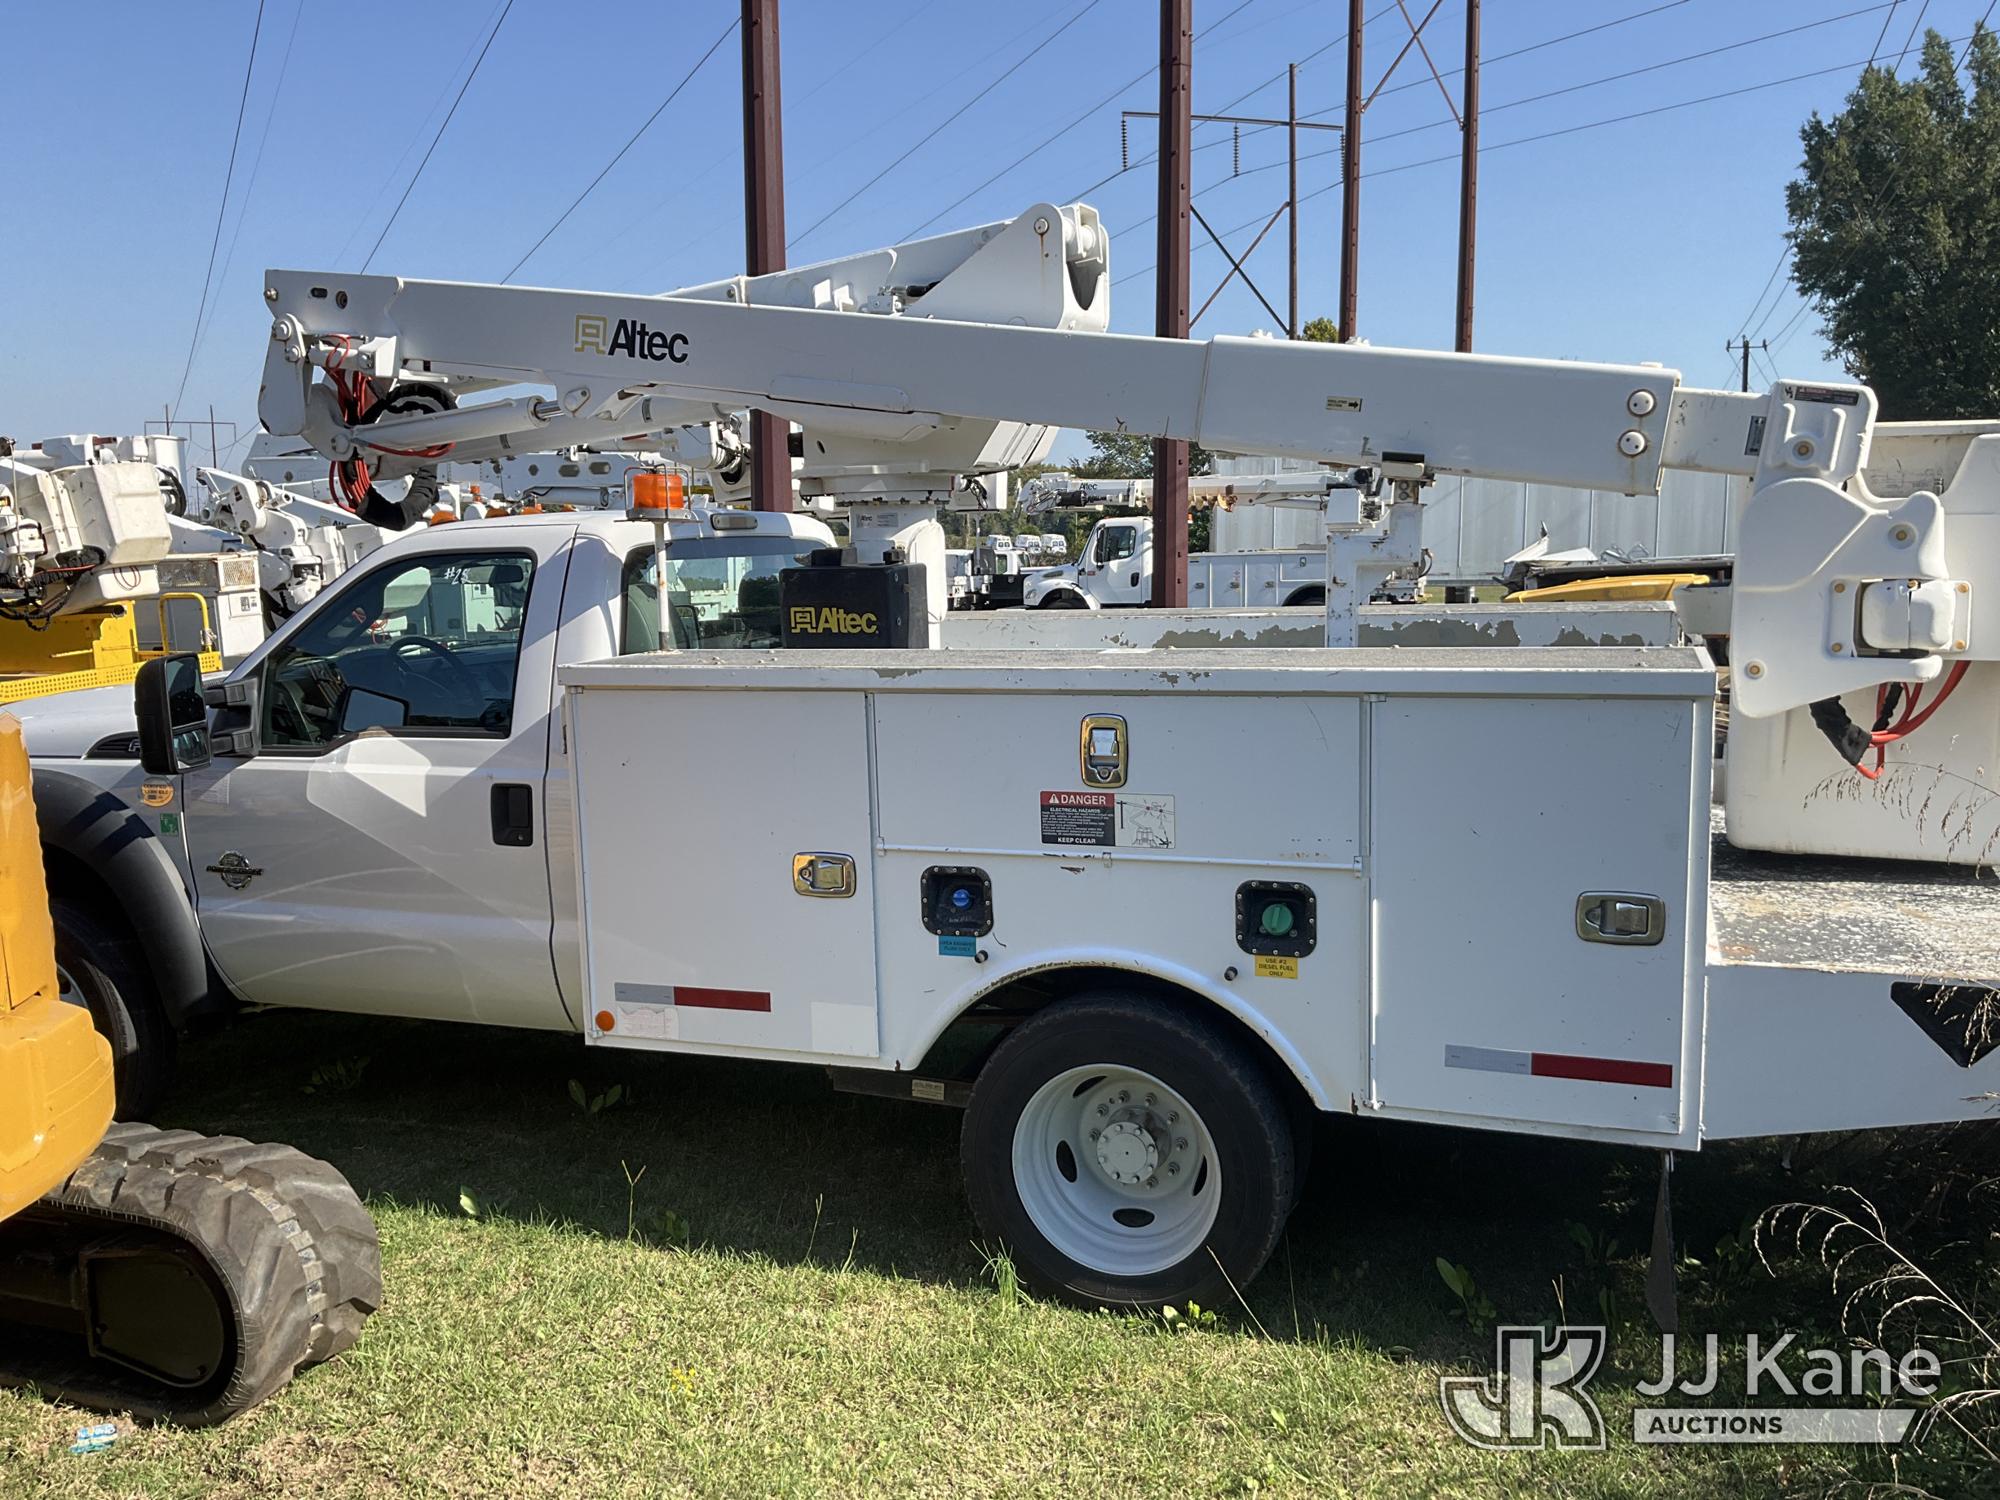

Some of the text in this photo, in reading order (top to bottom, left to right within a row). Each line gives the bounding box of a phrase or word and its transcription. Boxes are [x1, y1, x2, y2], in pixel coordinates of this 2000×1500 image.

[608, 319, 689, 363] Altec
[817, 607, 878, 634] Altec
[1060, 794, 1106, 805] DANGER
